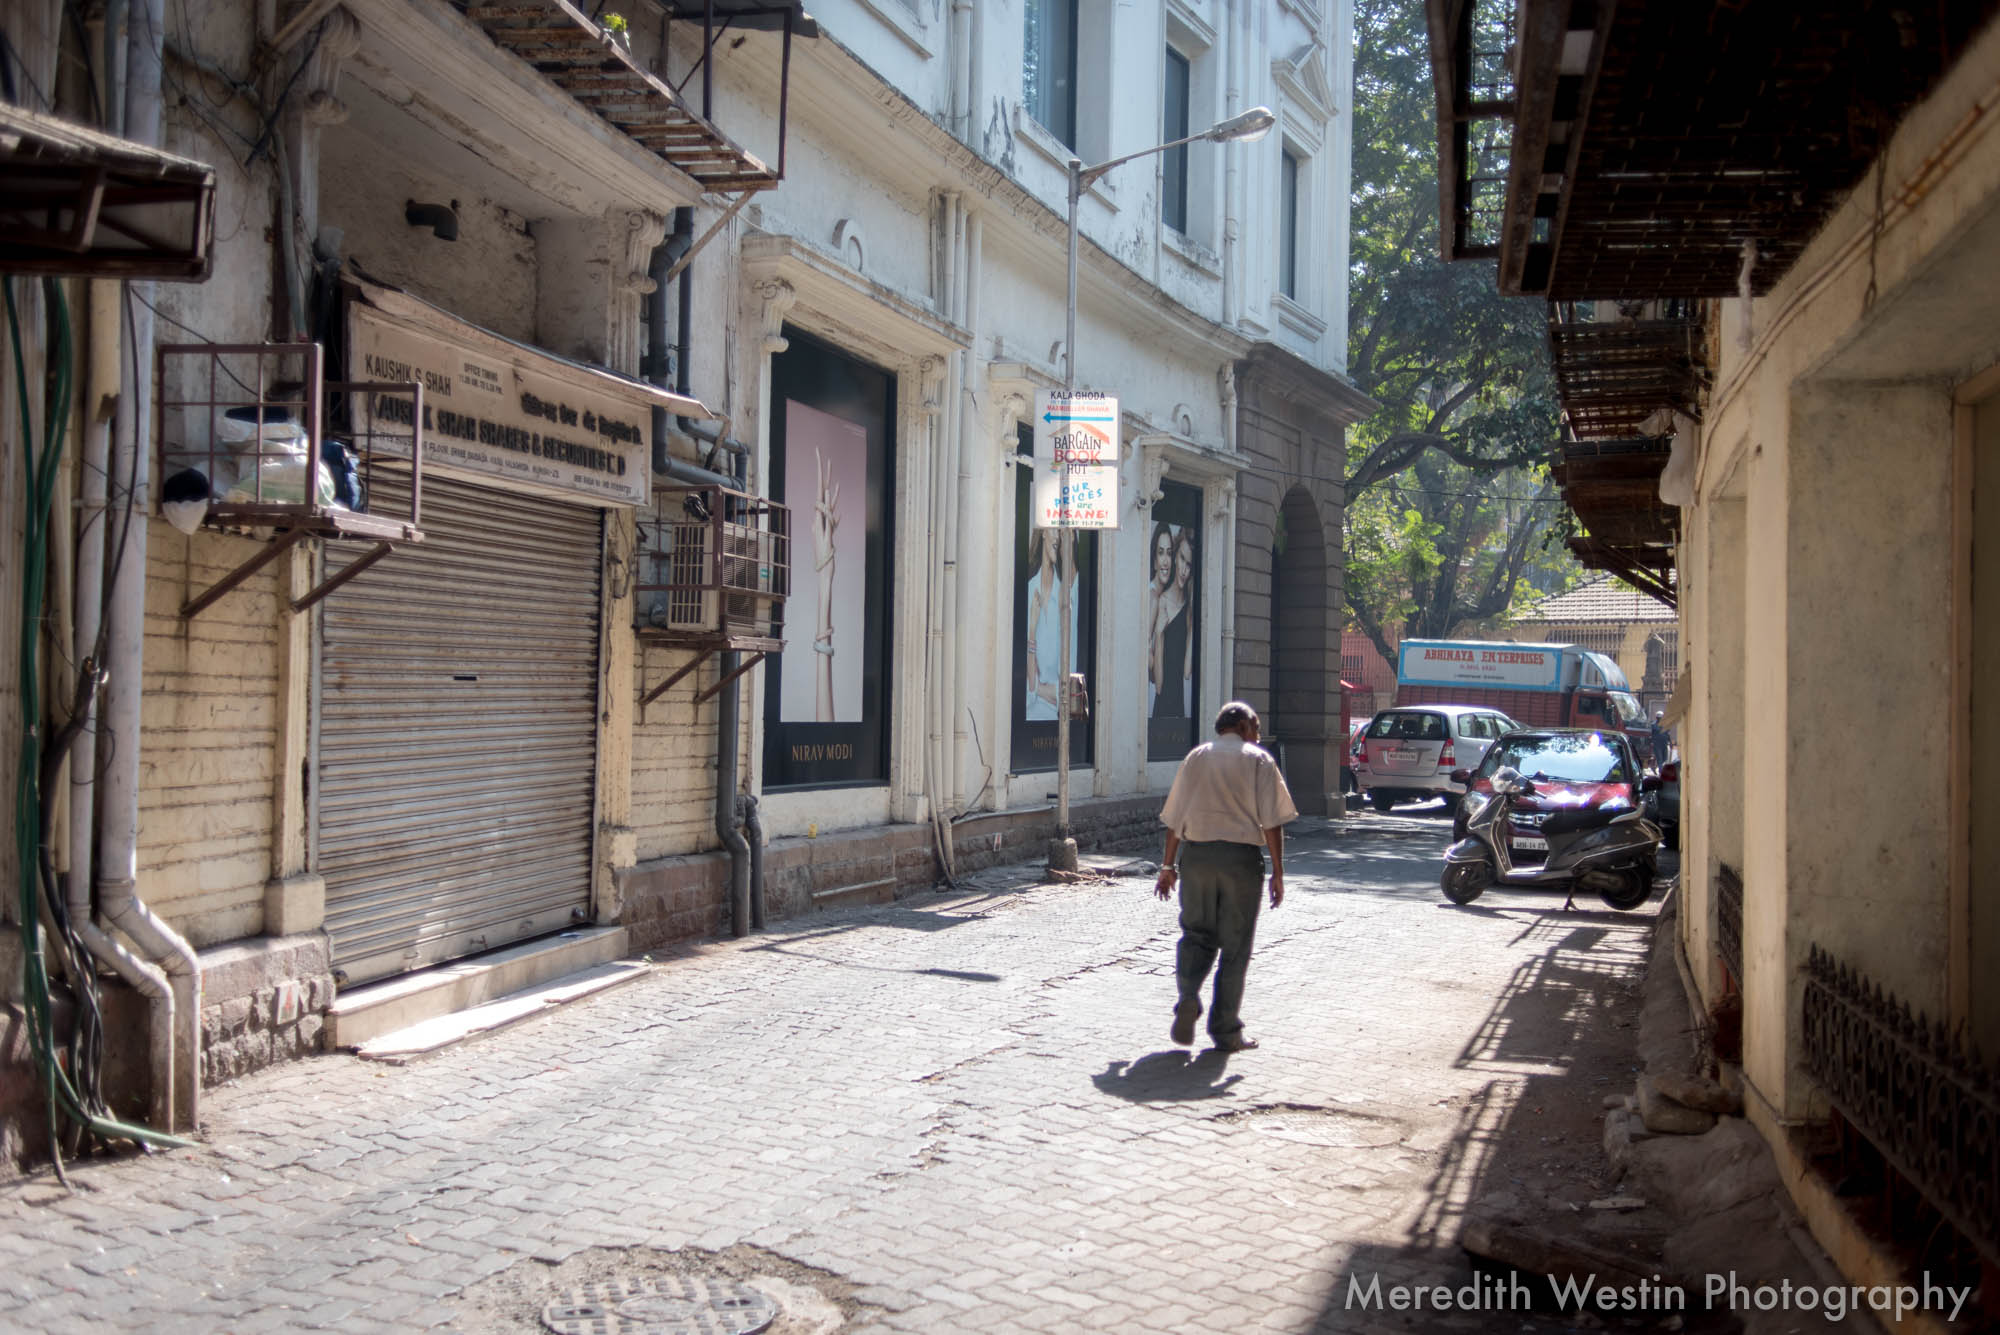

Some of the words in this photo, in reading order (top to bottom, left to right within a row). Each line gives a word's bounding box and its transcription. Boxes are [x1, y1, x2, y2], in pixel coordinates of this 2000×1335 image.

[365, 354, 411, 382] KAUSHIK
[425, 371, 451, 396] SHAH
[1050, 391, 1073, 400] KALA
[1075, 391, 1106, 400] GHODA
[437, 409, 476, 441] SHAH
[480, 420, 530, 454] SHARES
[543, 436, 605, 471] SECURITIES
[606, 452, 626, 476] LD
[1054, 431, 1101, 449] BARGAIN
[1054, 449, 1102, 464] BOOK
[1067, 464, 1088, 474] HUT
[1062, 482, 1090, 495] OUR
[1054, 488, 1102, 507] PRICES
[1047, 508, 1109, 518] INSANE!
[1424, 649, 1475, 662] ABHINAYA
[1481, 651, 1545, 665] ENTERPRISES
[792, 743, 825, 761] NIRAV
[826, 743, 853, 761] MODI
